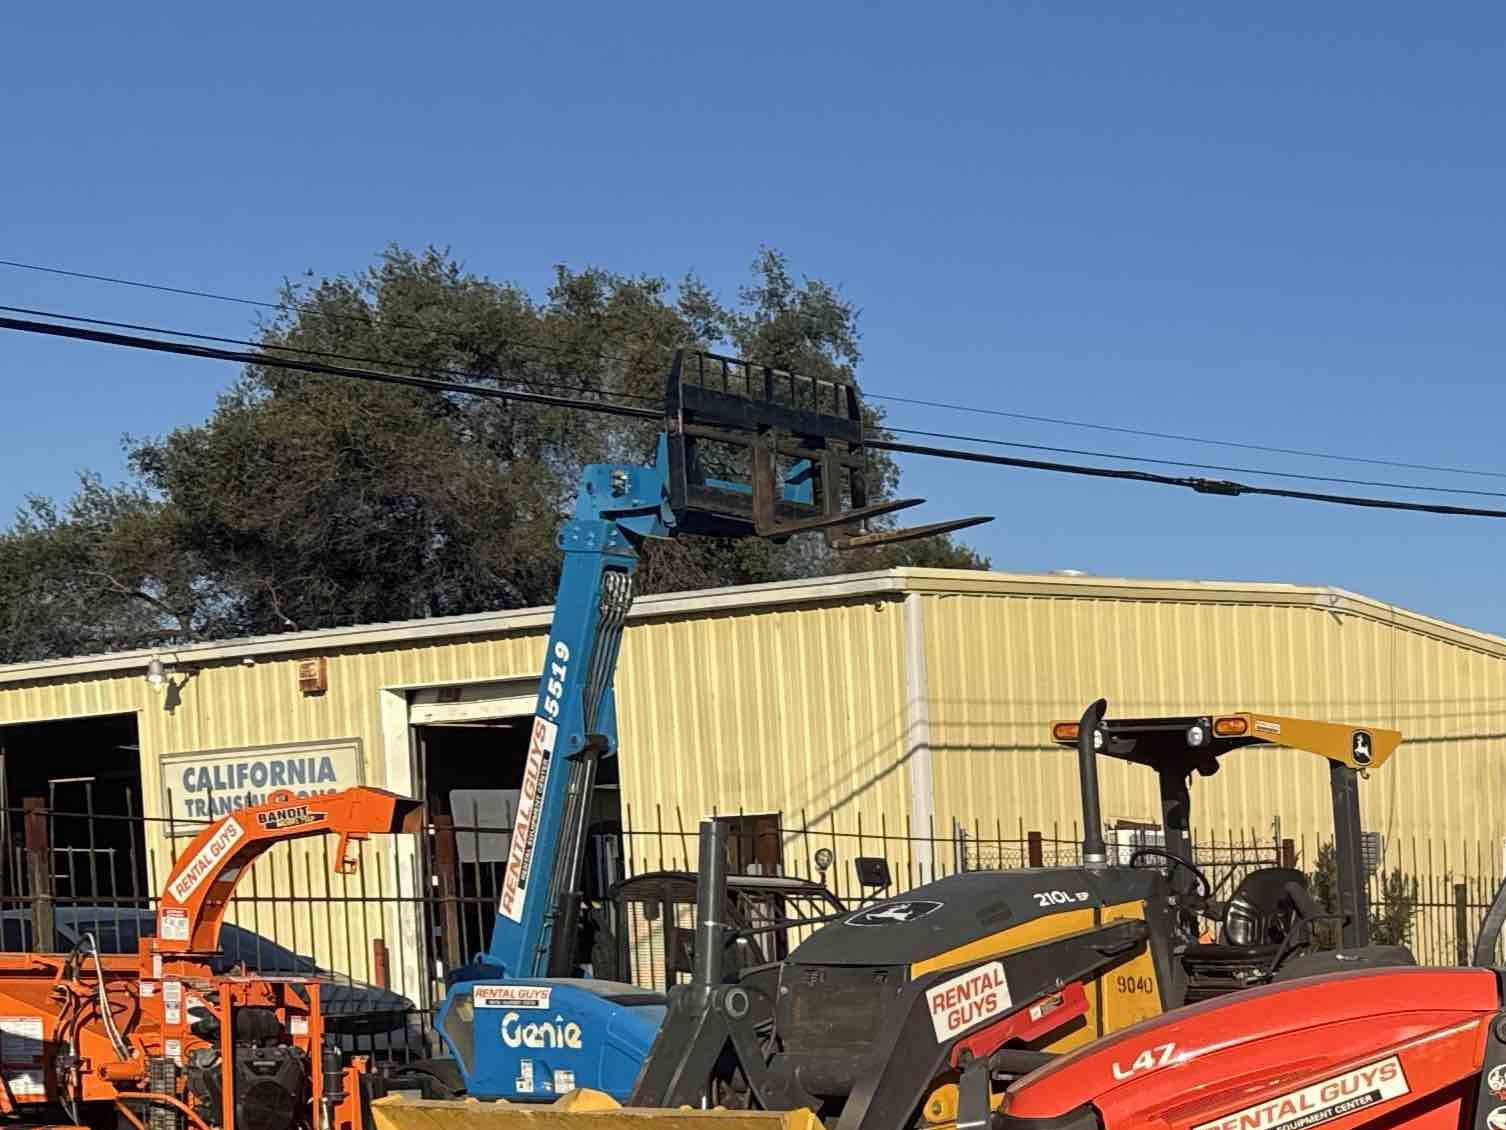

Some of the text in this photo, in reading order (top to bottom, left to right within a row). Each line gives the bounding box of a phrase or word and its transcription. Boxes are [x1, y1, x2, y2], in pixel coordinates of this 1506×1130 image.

[544, 641, 570, 718] 5519
[183, 756, 336, 793] CALIFORNIA
[258, 806, 308, 824] BANDIT
[501, 720, 546, 914] RENTAL GUYS
[175, 854, 214, 897] RENTAL
[210, 824, 239, 858] GUYS
[1033, 890, 1076, 906] 210L
[475, 986, 516, 999] RENTAL
[932, 967, 1004, 1015] RENTAL
[1117, 976, 1153, 994] 9040
[501, 1011, 582, 1049] Genie
[947, 993, 998, 1030] GUYS
[1111, 1042, 1178, 1080] L47
[1320, 1062, 1398, 1102] GUYS
[1335, 1095, 1374, 1116] CENTER
